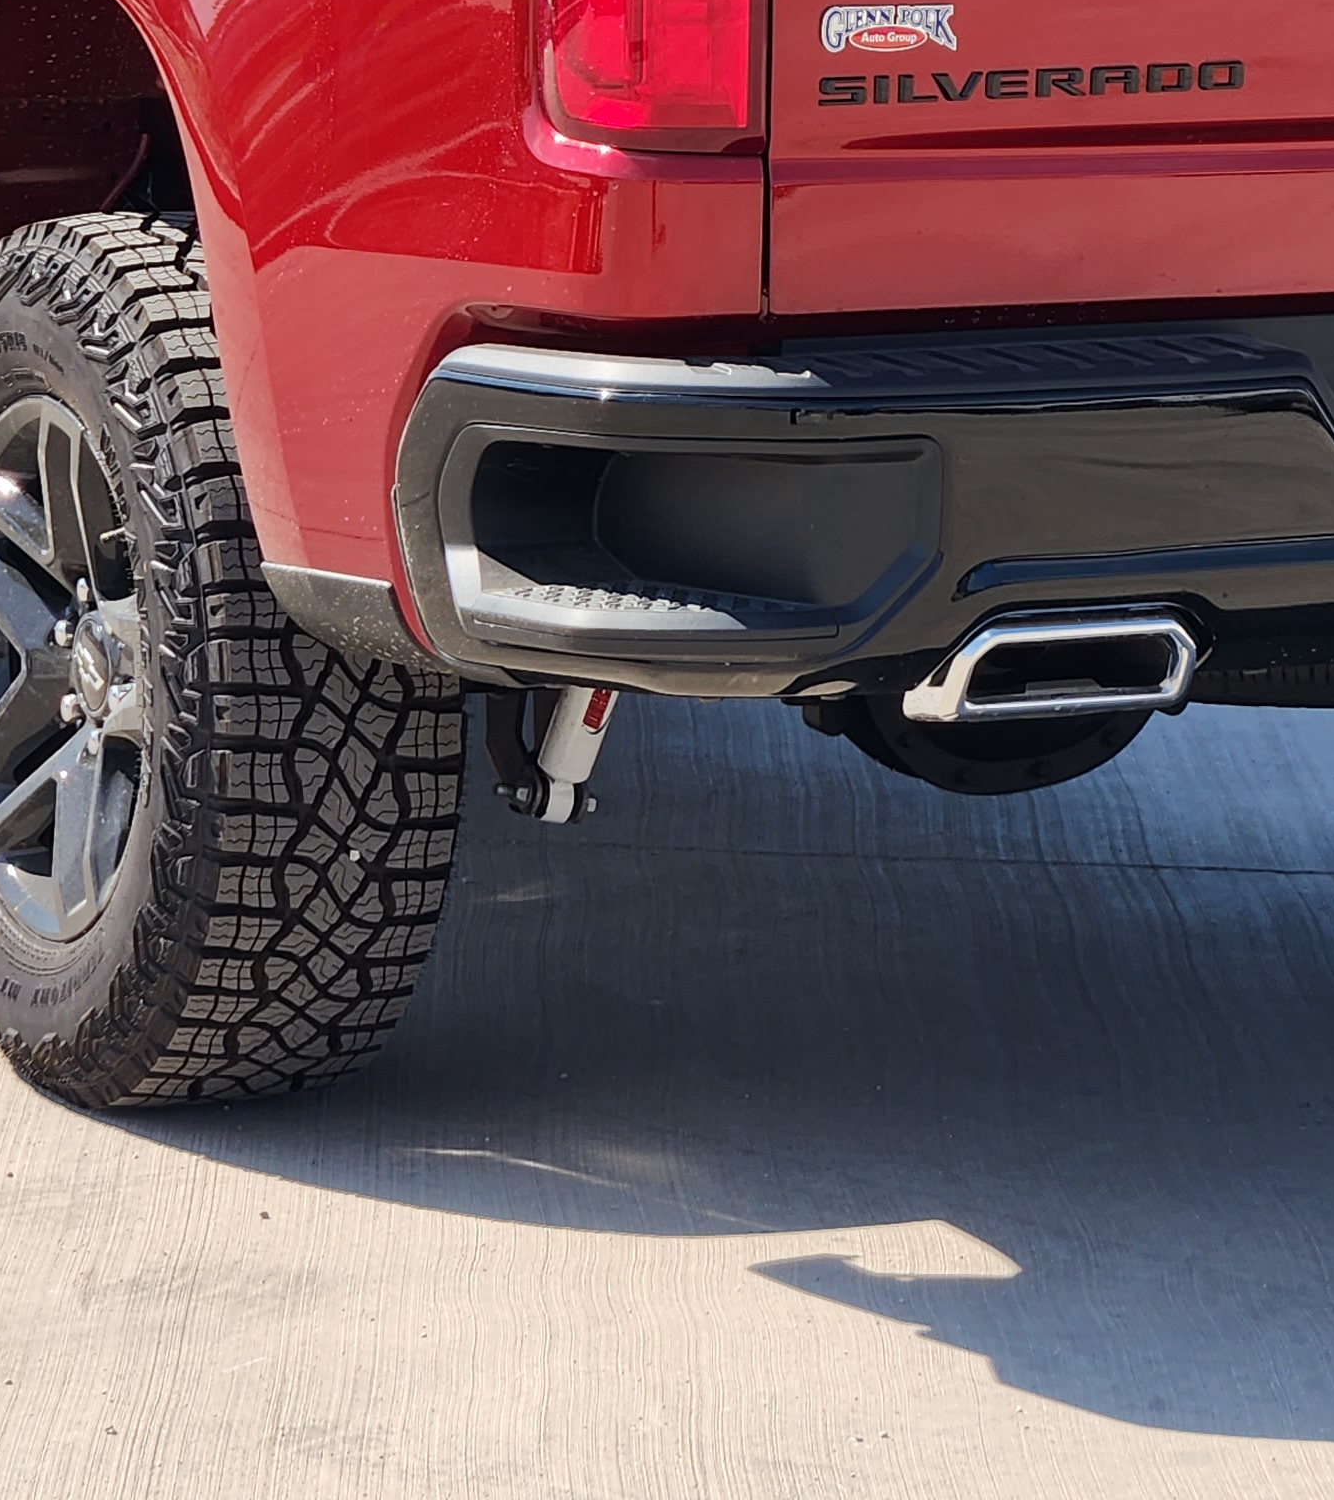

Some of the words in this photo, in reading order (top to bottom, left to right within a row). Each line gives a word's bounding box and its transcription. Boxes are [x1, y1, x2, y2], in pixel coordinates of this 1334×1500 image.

[823, 6, 894, 51] GLENN
[898, 5, 956, 50] POLK
[860, 32, 885, 44] Auto
[887, 31, 918, 45] Group
[818, 60, 1245, 107] SILVERADO
